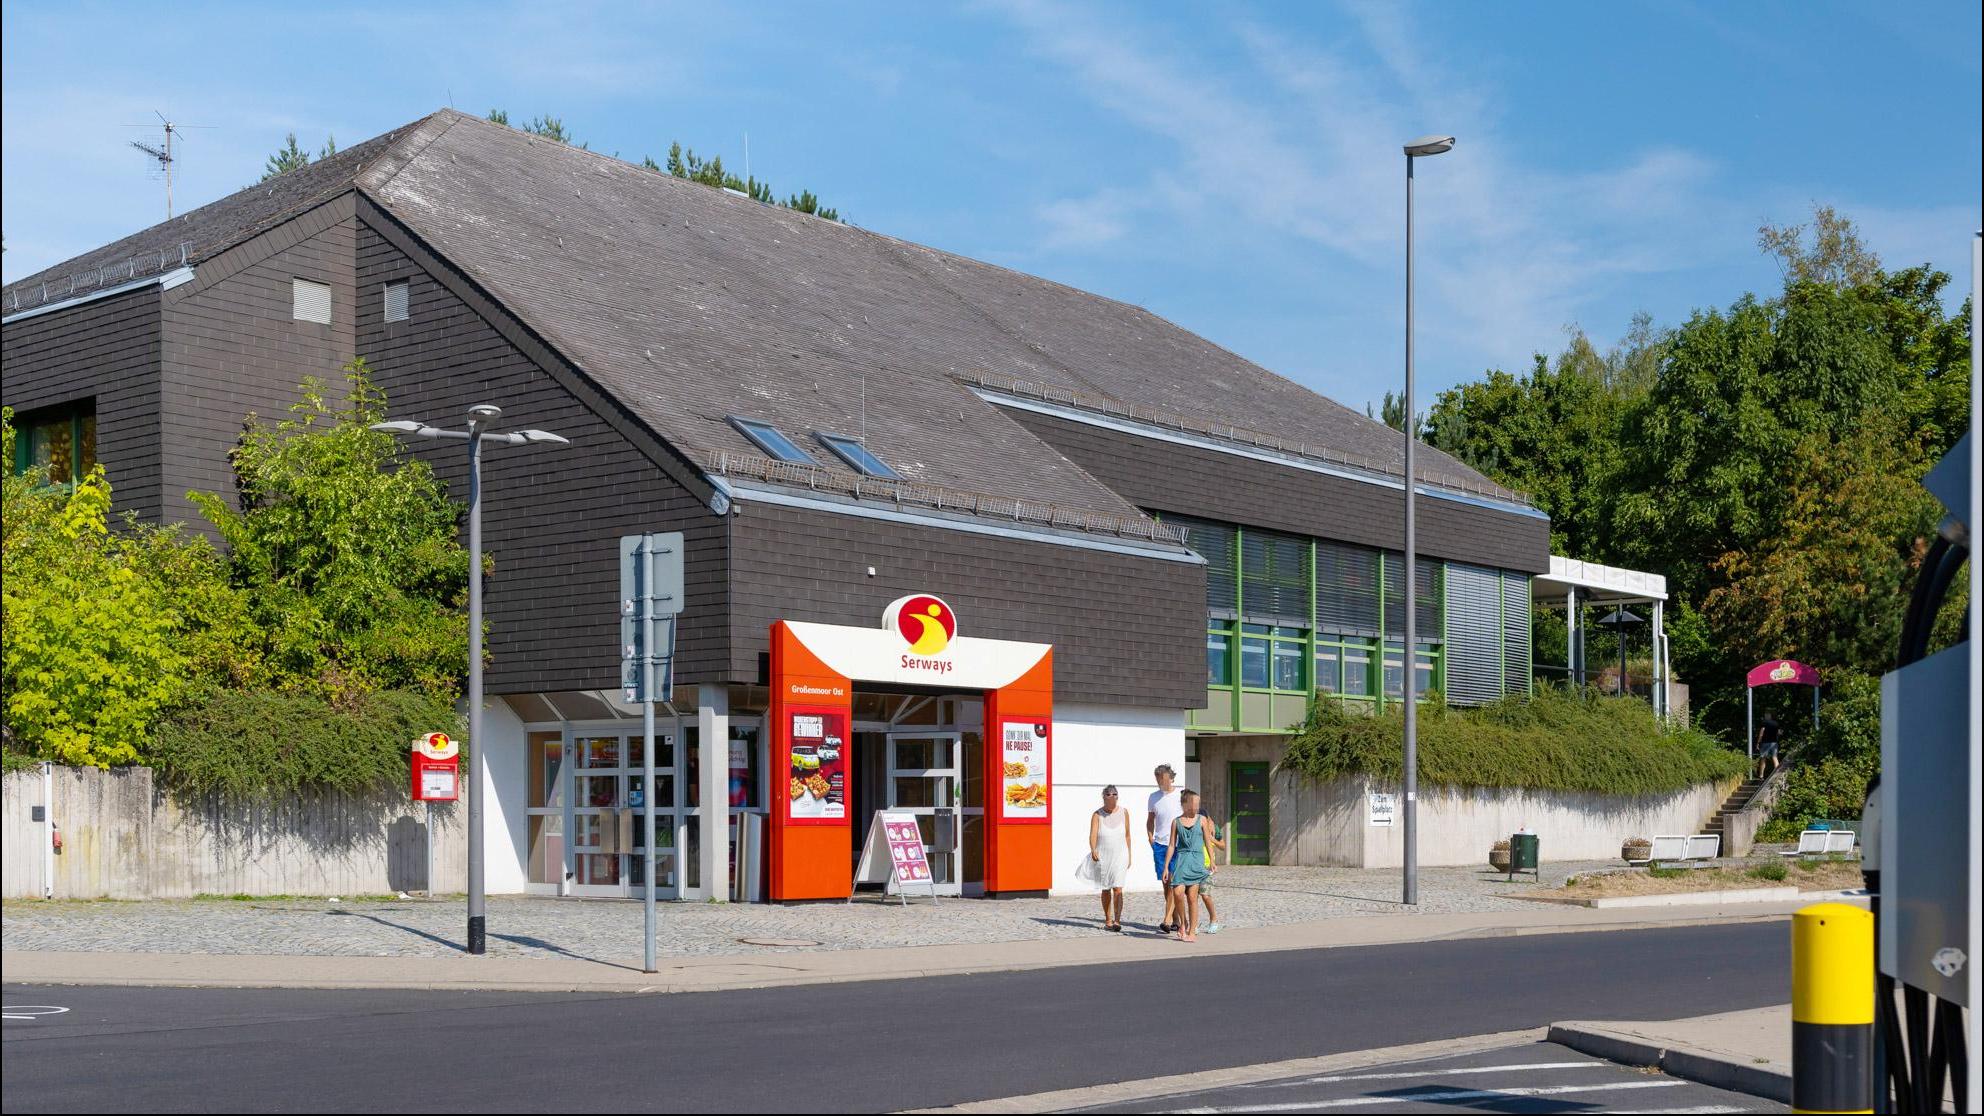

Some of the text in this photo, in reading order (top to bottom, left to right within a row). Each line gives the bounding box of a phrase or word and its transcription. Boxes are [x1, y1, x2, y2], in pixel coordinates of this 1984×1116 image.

[901, 655, 952, 674] Serways
[791, 685, 844, 696] Großenmoor Ost
[1014, 741, 1032, 751] PAUSE!
